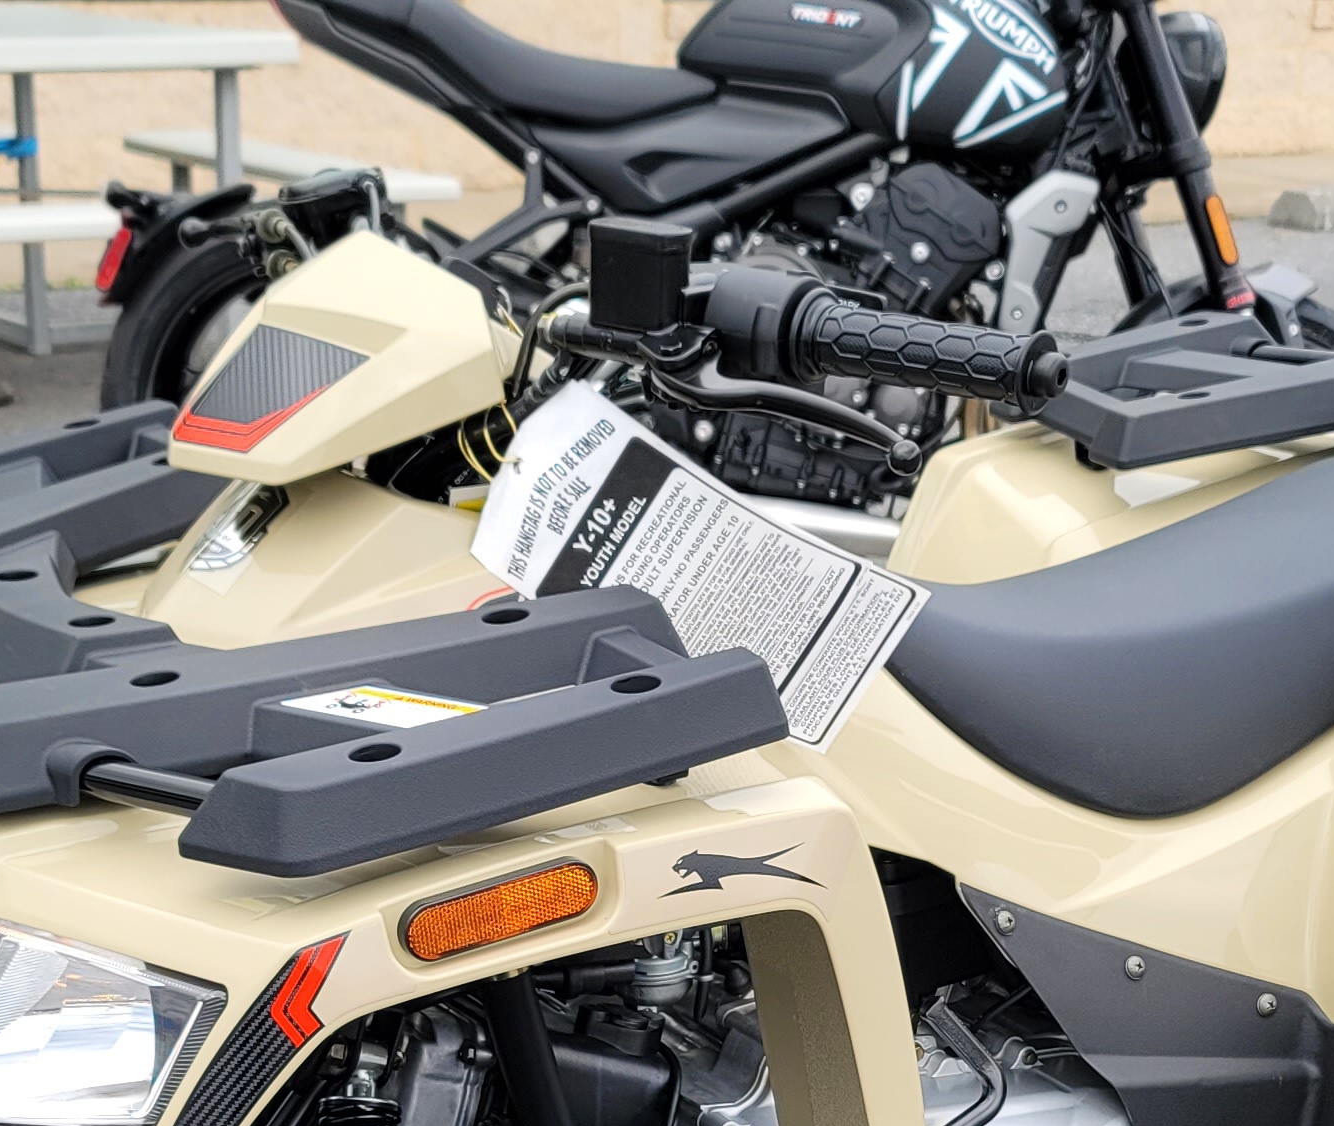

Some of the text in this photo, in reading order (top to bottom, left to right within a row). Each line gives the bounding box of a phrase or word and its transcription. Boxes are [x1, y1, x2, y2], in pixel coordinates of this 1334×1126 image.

[949, 0, 1057, 76] RIUMPH
[506, 418, 615, 580] THIS HANGTAG IS NOT TO BE REMOVED
[546, 475, 591, 535] BEFORE SALE
[572, 498, 615, 552] Y-10+
[579, 496, 646, 586] YOUTH MODEL
[621, 552, 640, 574] FOR
[635, 481, 686, 553] RECREATIONAL
[638, 494, 707, 594] DULT SUPERVISION
[649, 495, 691, 554] OPERATORS
[683, 498, 728, 562] PASSENGERS
[664, 514, 739, 621] RATOR UNDER AGE 10
[773, 568, 836, 659] YOUR DEALER TO FIND OUT
[779, 567, 845, 664] OR LOCAL LAWS REGARDING
[785, 654, 796, 669] ATV
